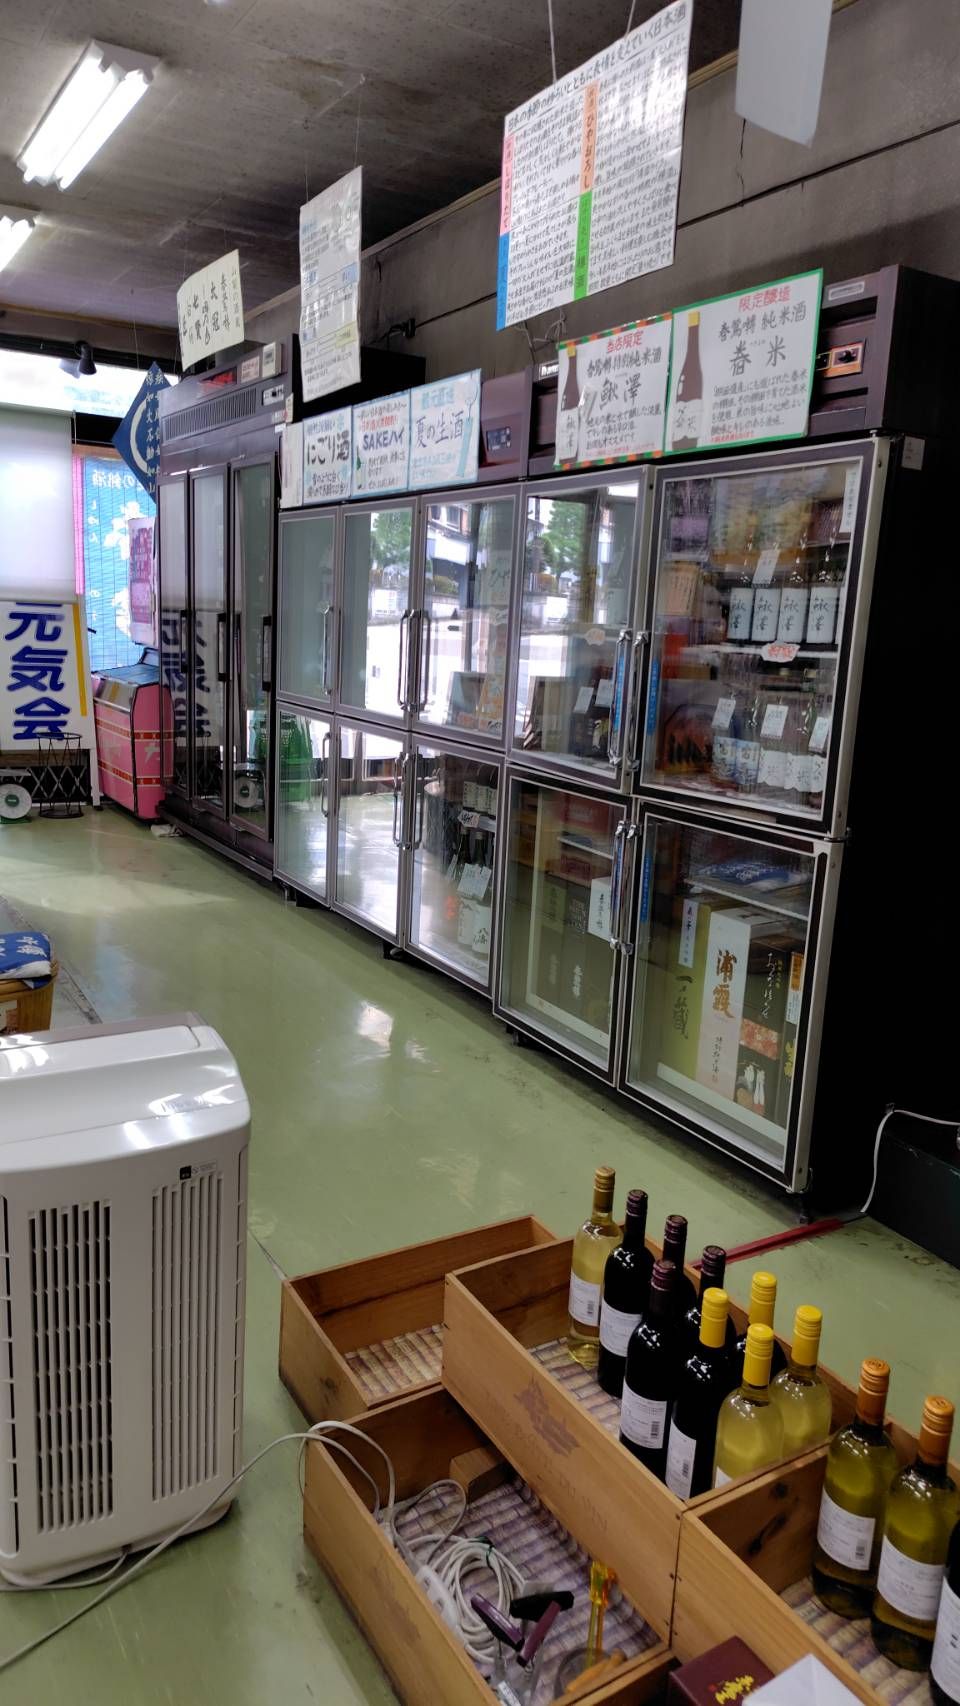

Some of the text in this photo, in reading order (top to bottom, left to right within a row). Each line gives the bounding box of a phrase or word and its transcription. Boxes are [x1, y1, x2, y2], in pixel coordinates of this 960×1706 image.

[739, 286, 791, 312] 限定醸造
[762, 301, 807, 329] 純米酒
[307, 430, 350, 465] にごり酒
[362, 429, 405, 451] SAKEハイ
[415, 411, 464, 449] 夏の生酒
[4, 602, 72, 741] 元気会
[712, 949, 738, 1020] 浦霞
